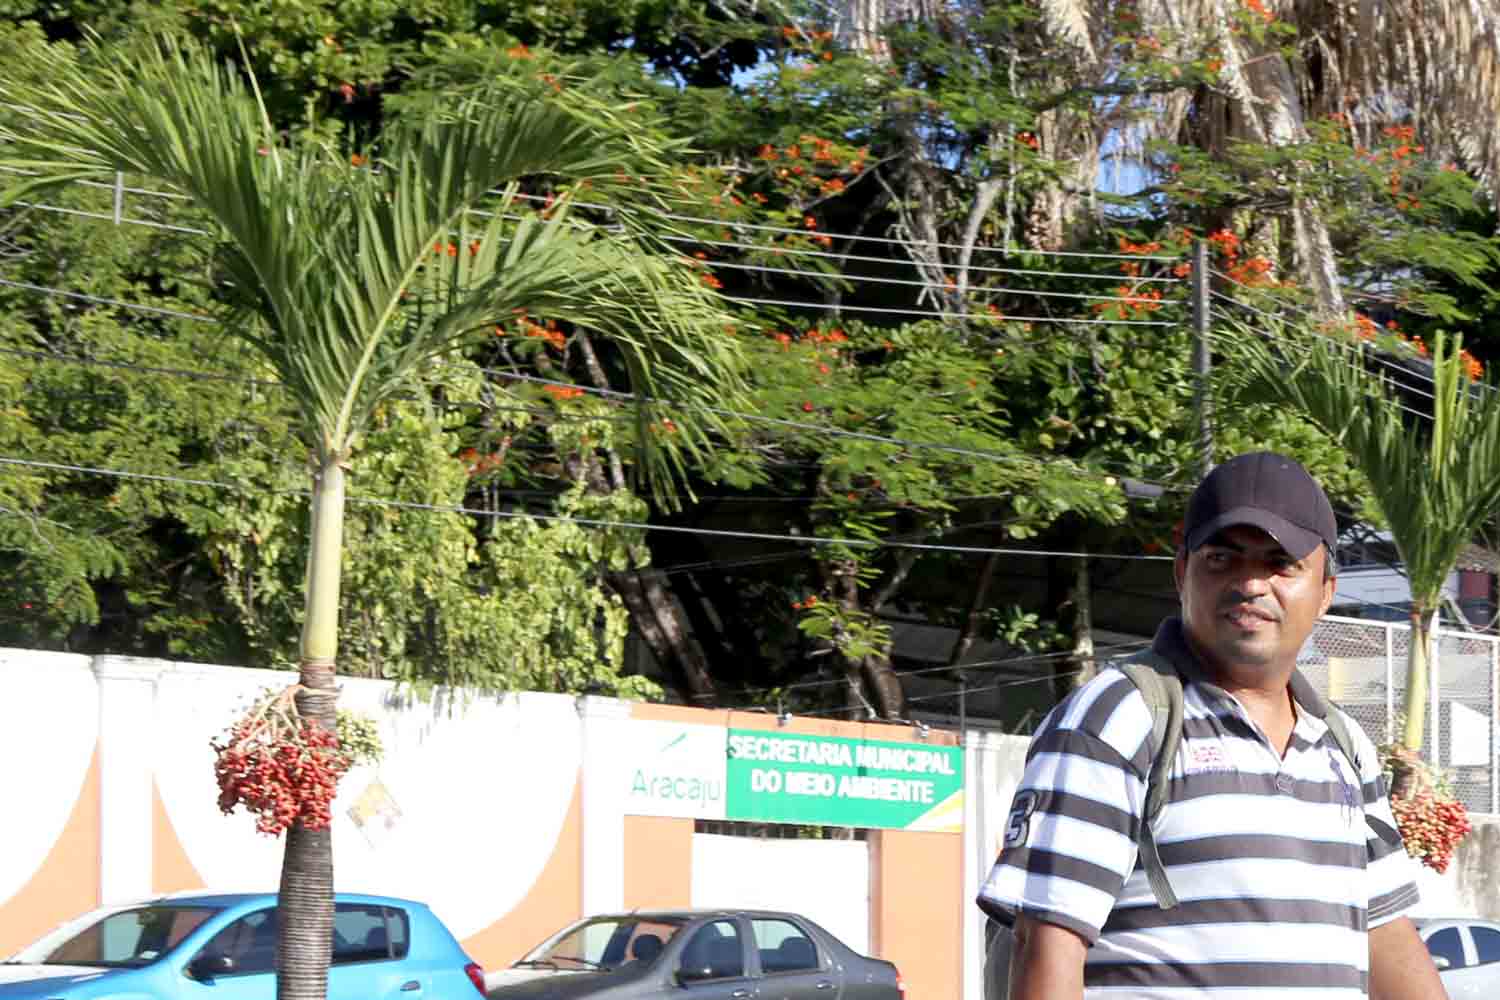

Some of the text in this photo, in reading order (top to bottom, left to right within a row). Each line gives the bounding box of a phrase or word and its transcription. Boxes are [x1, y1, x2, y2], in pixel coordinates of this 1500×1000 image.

[729, 735, 955, 775] SECRETARIA MUNICIPAL
[629, 768, 721, 809] Aracaju
[751, 769, 935, 804] DO MEIO AMBIENTE
